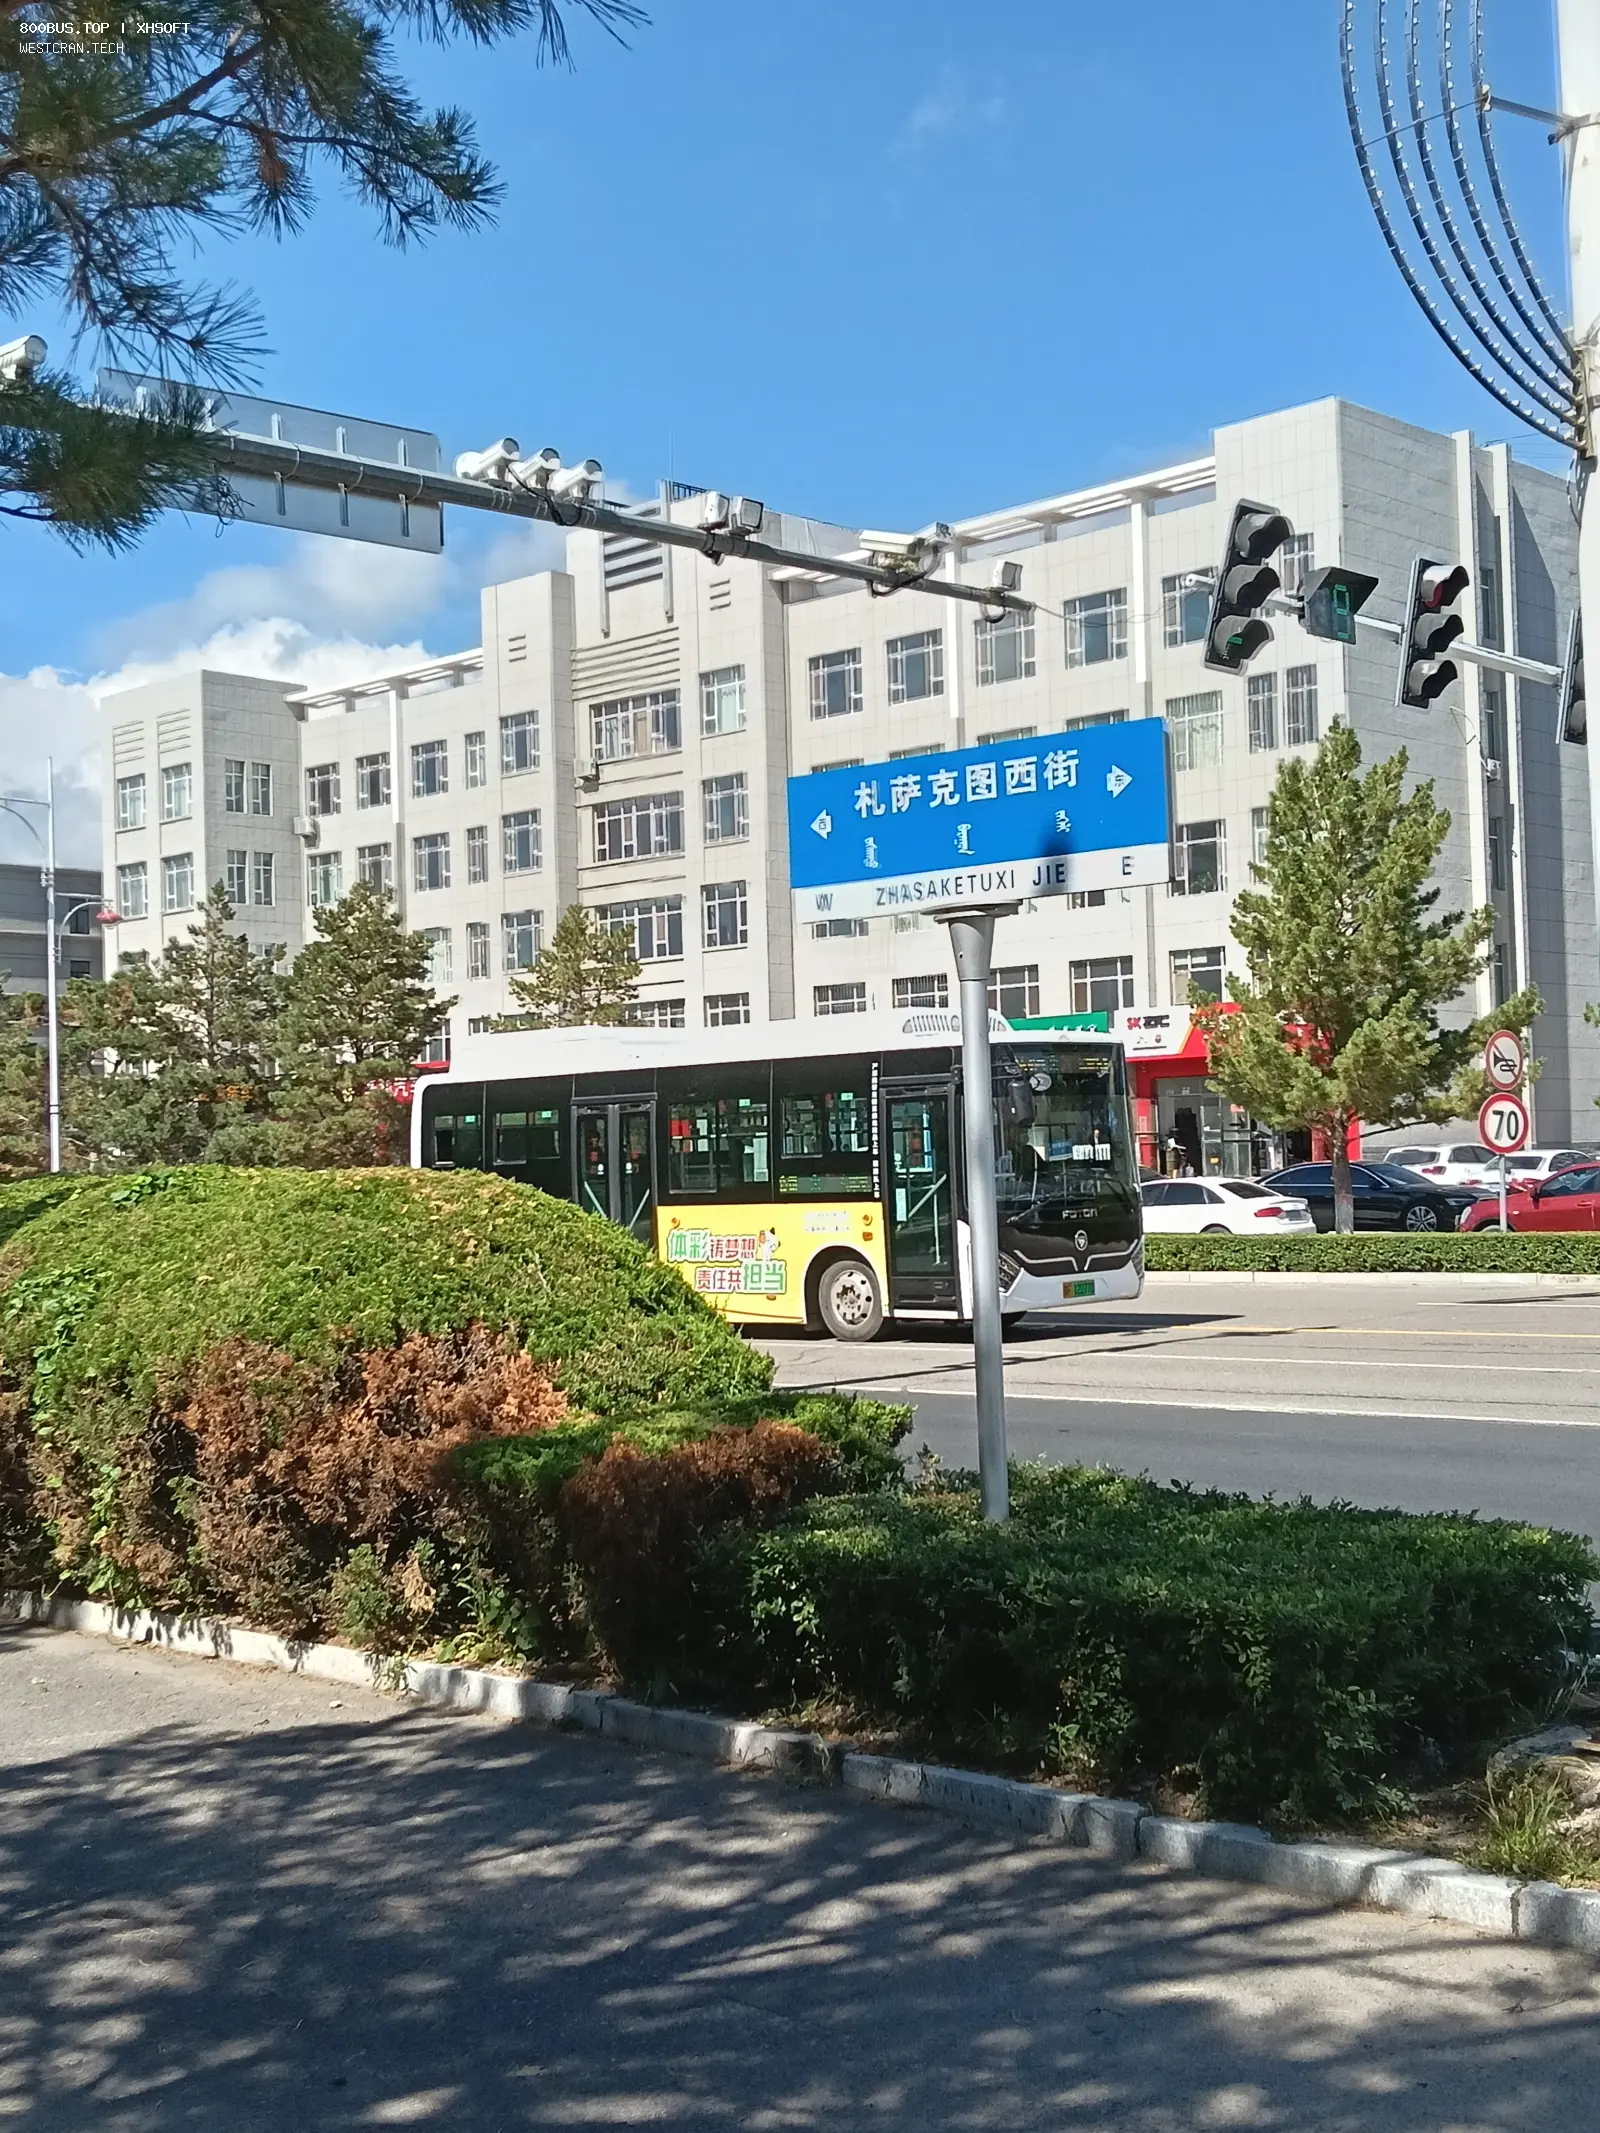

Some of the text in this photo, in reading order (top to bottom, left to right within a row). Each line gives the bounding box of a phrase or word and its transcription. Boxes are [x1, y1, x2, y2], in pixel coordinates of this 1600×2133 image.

[854, 749, 1080, 819] 札萨克图西街
[1122, 856, 1134, 876] E
[876, 863, 1067, 907] ZHASAKETUXI JIE
[1492, 1109, 1520, 1141] 70
[696, 1262, 785, 1291] 责任共担当
